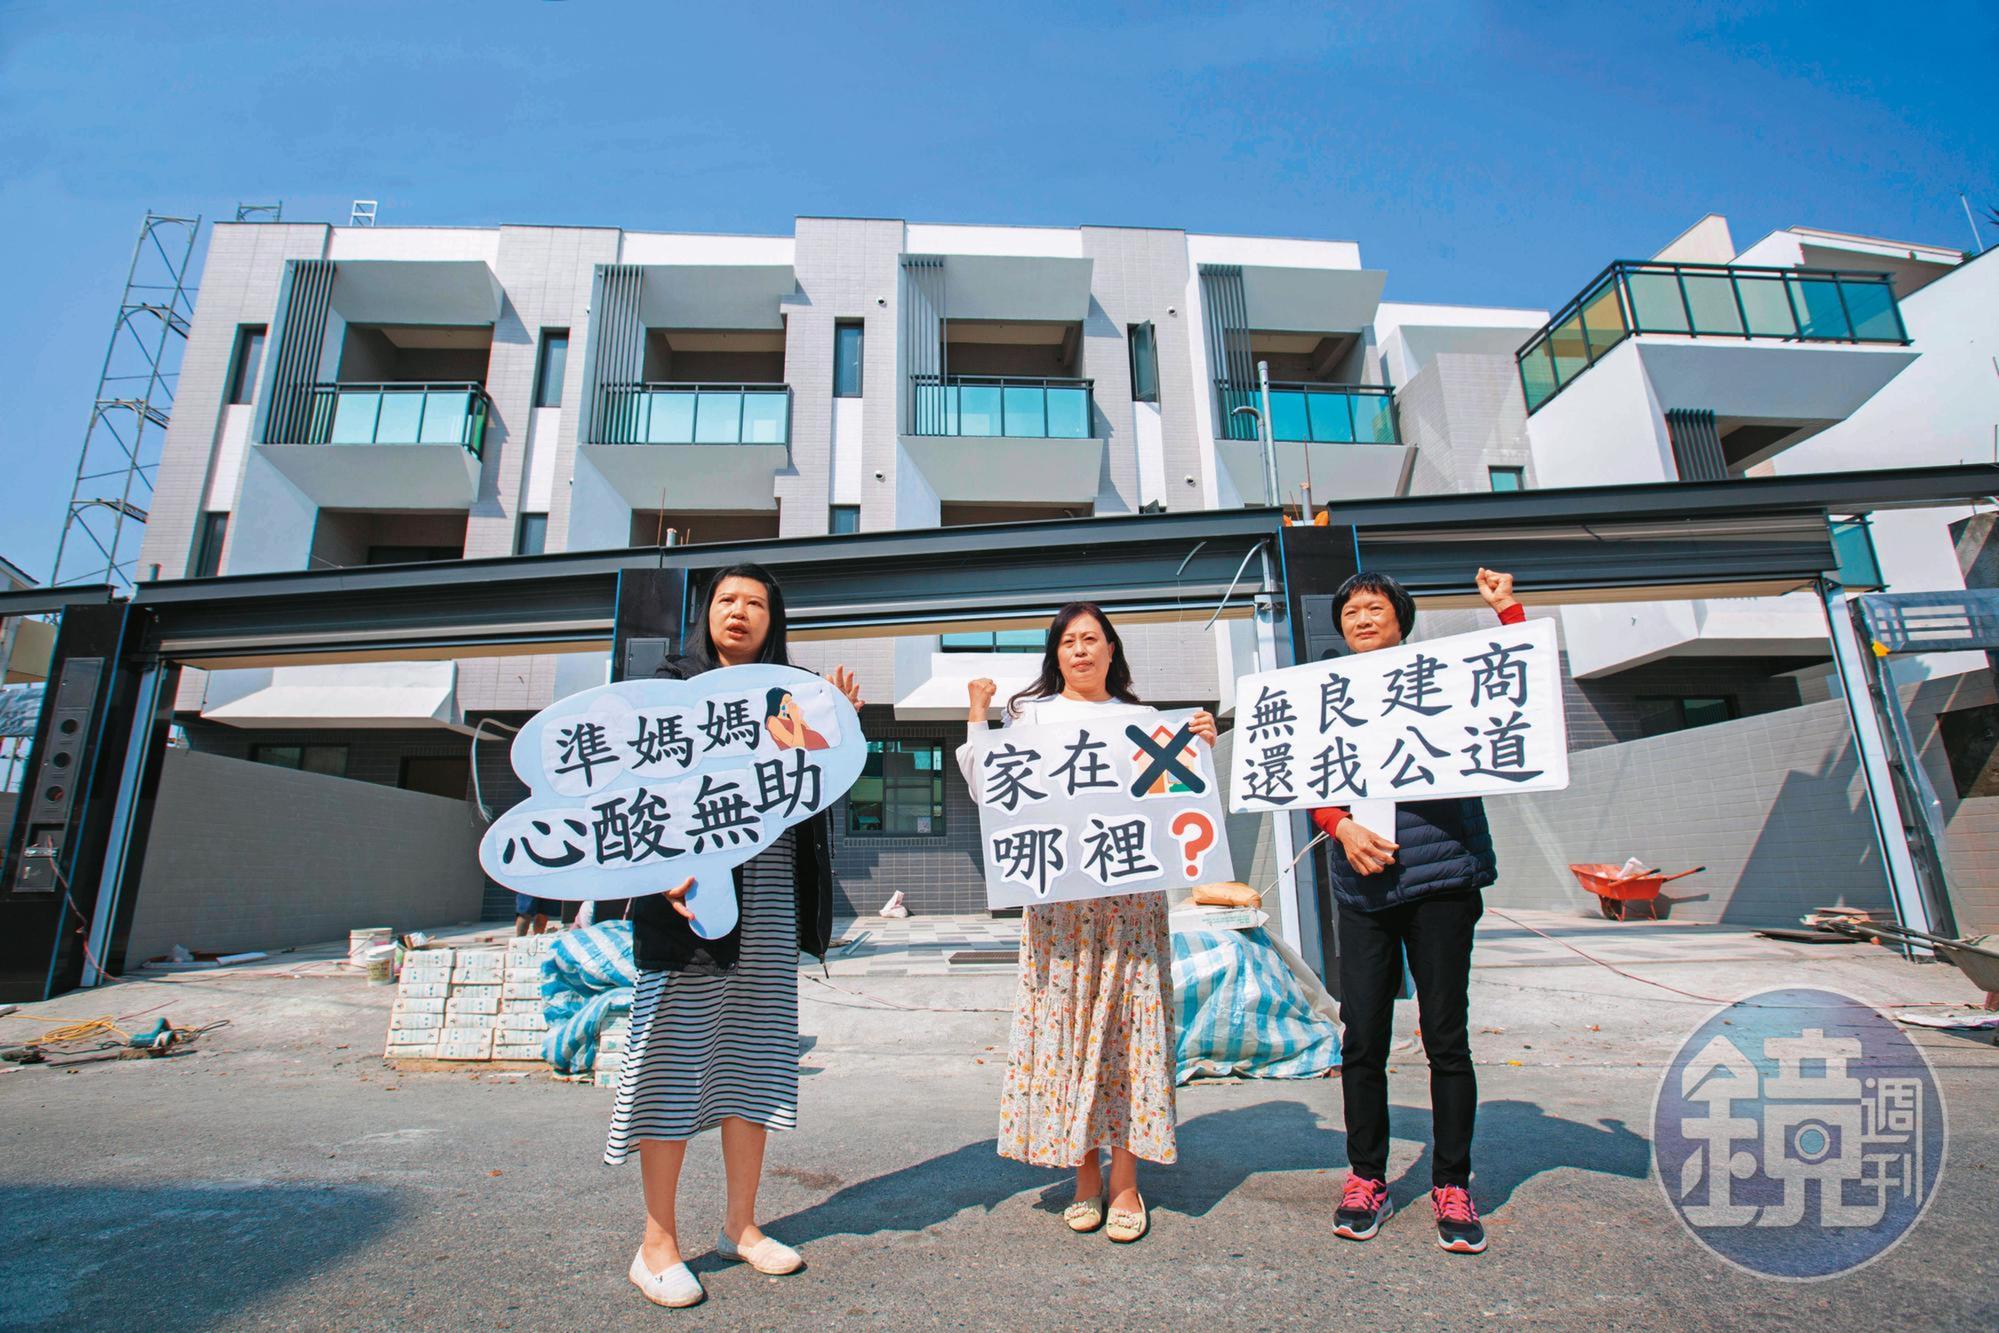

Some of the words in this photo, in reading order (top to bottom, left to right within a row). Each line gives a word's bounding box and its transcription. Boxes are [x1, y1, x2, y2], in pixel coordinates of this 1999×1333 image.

[1246, 642, 1534, 743] 無良建商
[555, 699, 760, 787] 準媽媽
[984, 729, 1118, 811] 家在
[1241, 710, 1544, 806] 還我公道
[503, 748, 822, 868] 心酸無助
